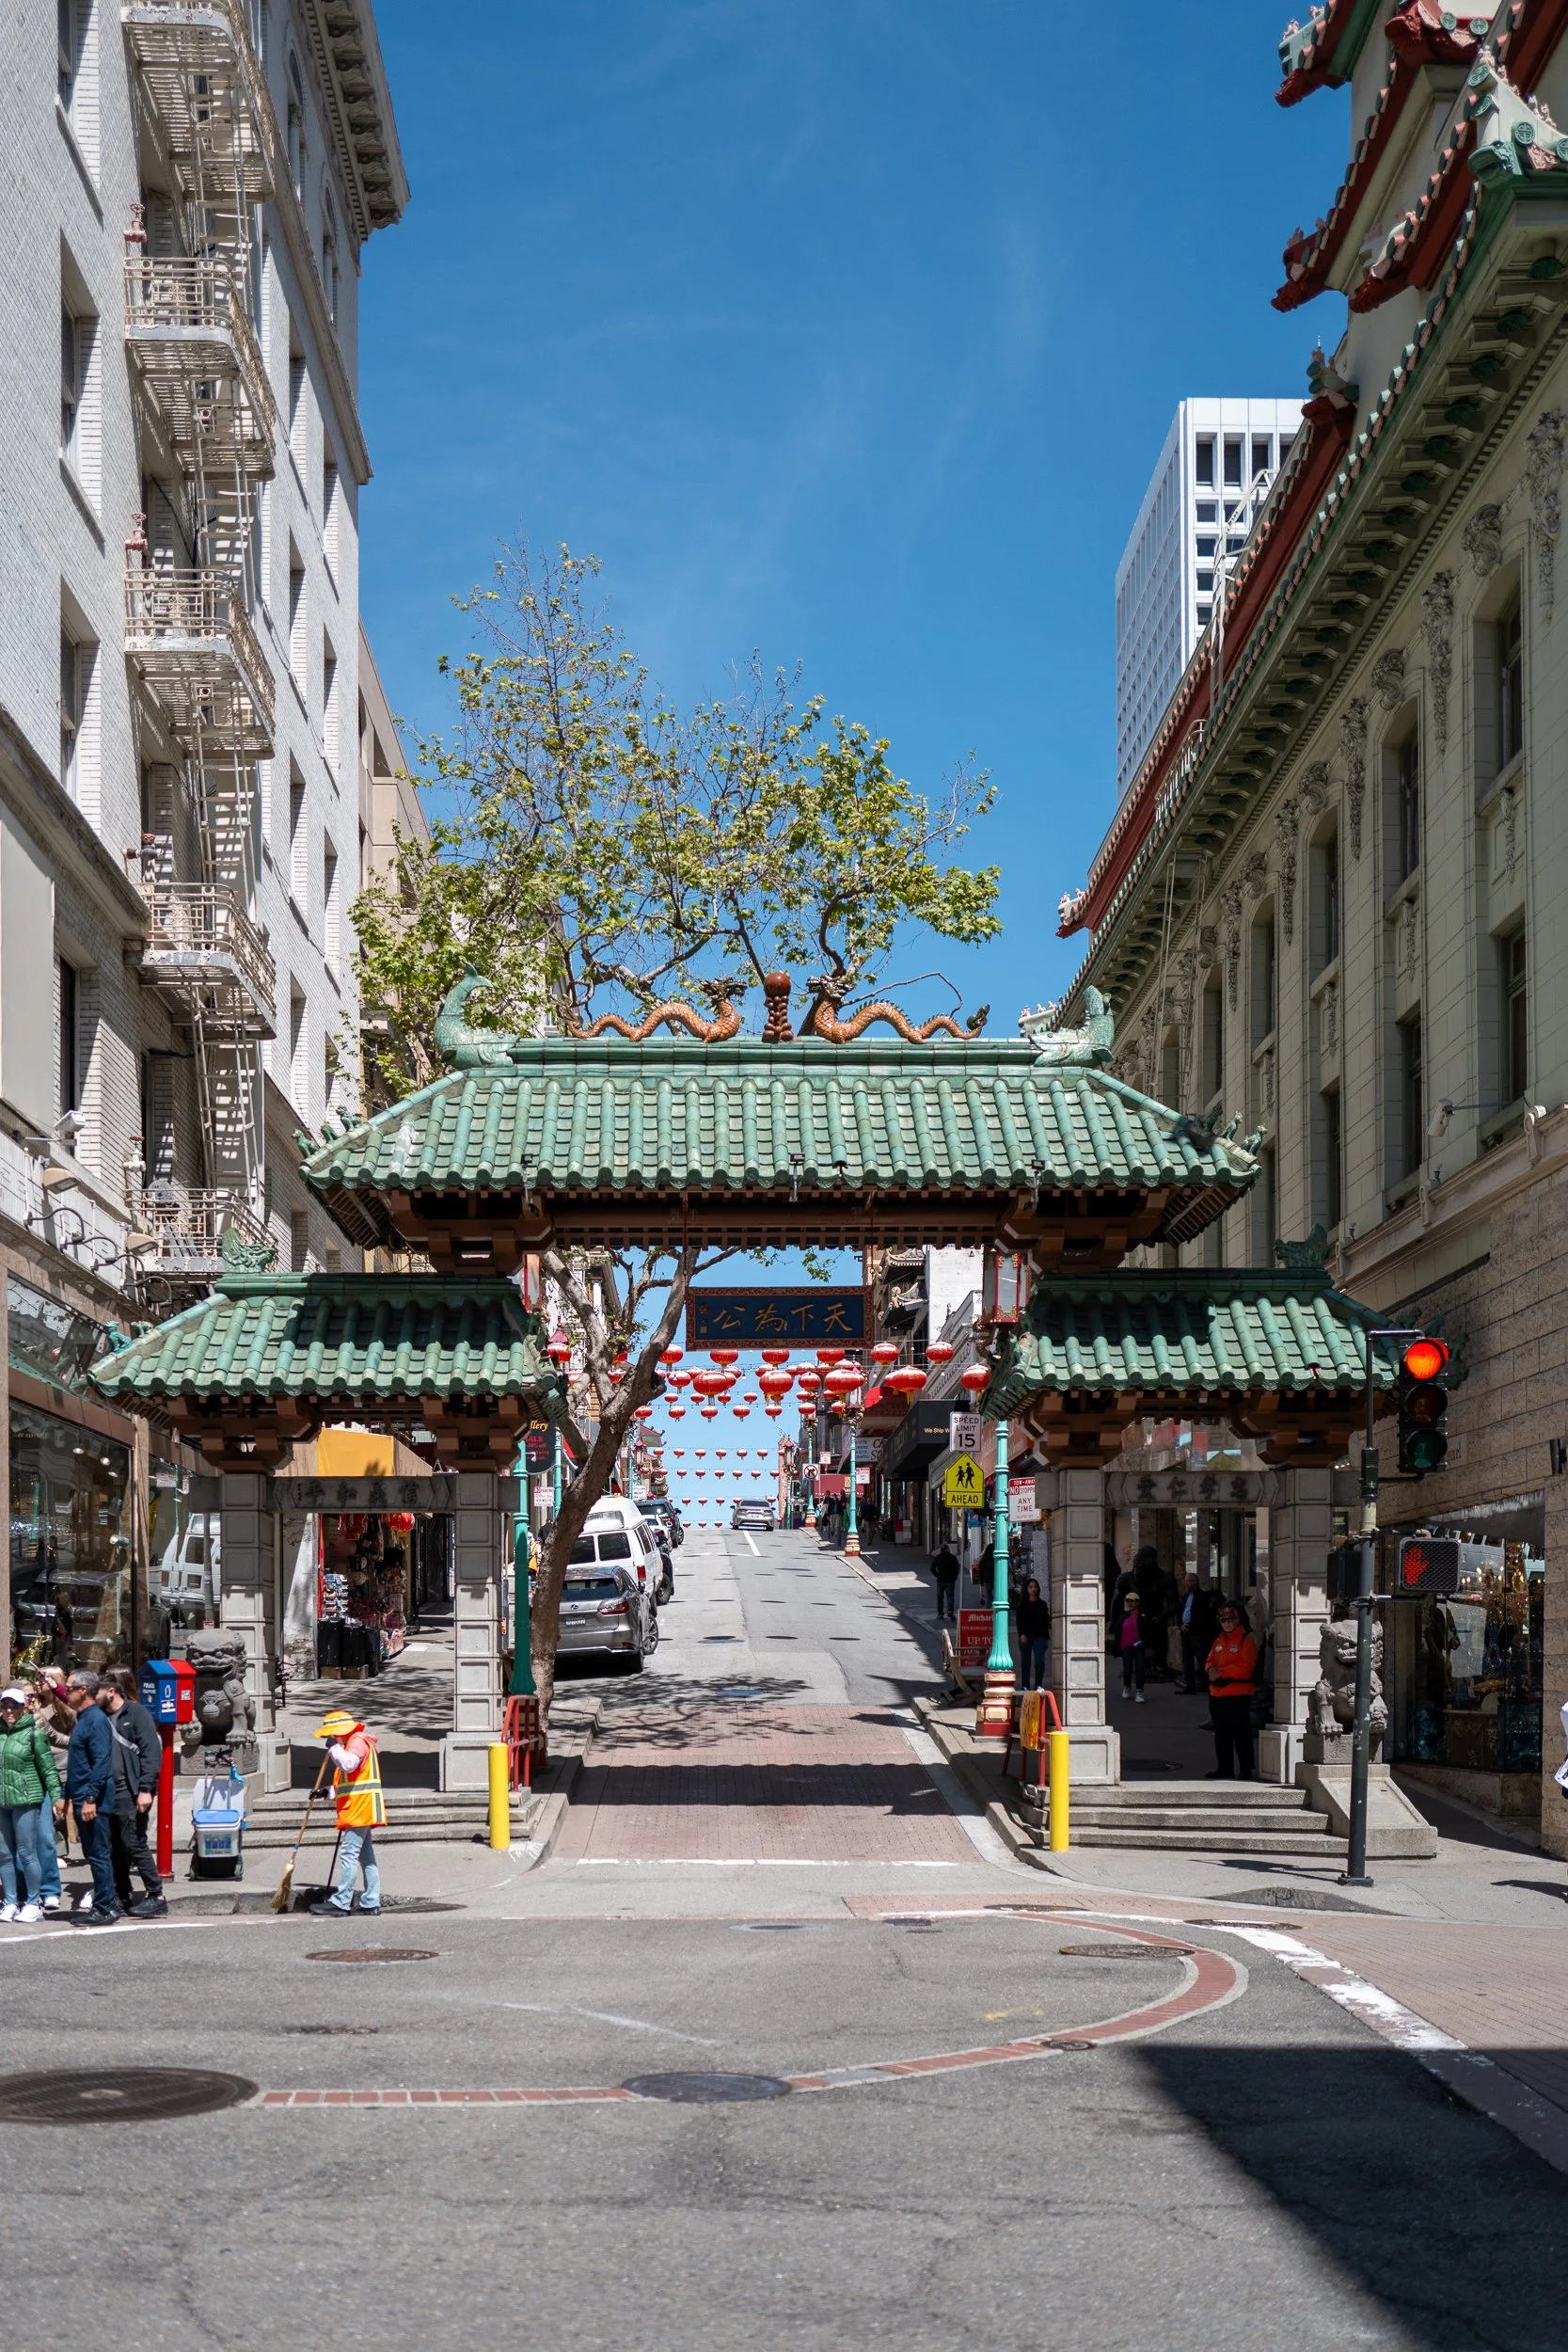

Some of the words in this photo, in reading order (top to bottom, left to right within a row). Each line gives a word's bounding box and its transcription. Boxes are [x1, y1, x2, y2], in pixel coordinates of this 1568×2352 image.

[958, 1433, 975, 1448] 15
[1009, 1486, 1019, 1495] NO
[951, 1495, 979, 1504] AHEAD
